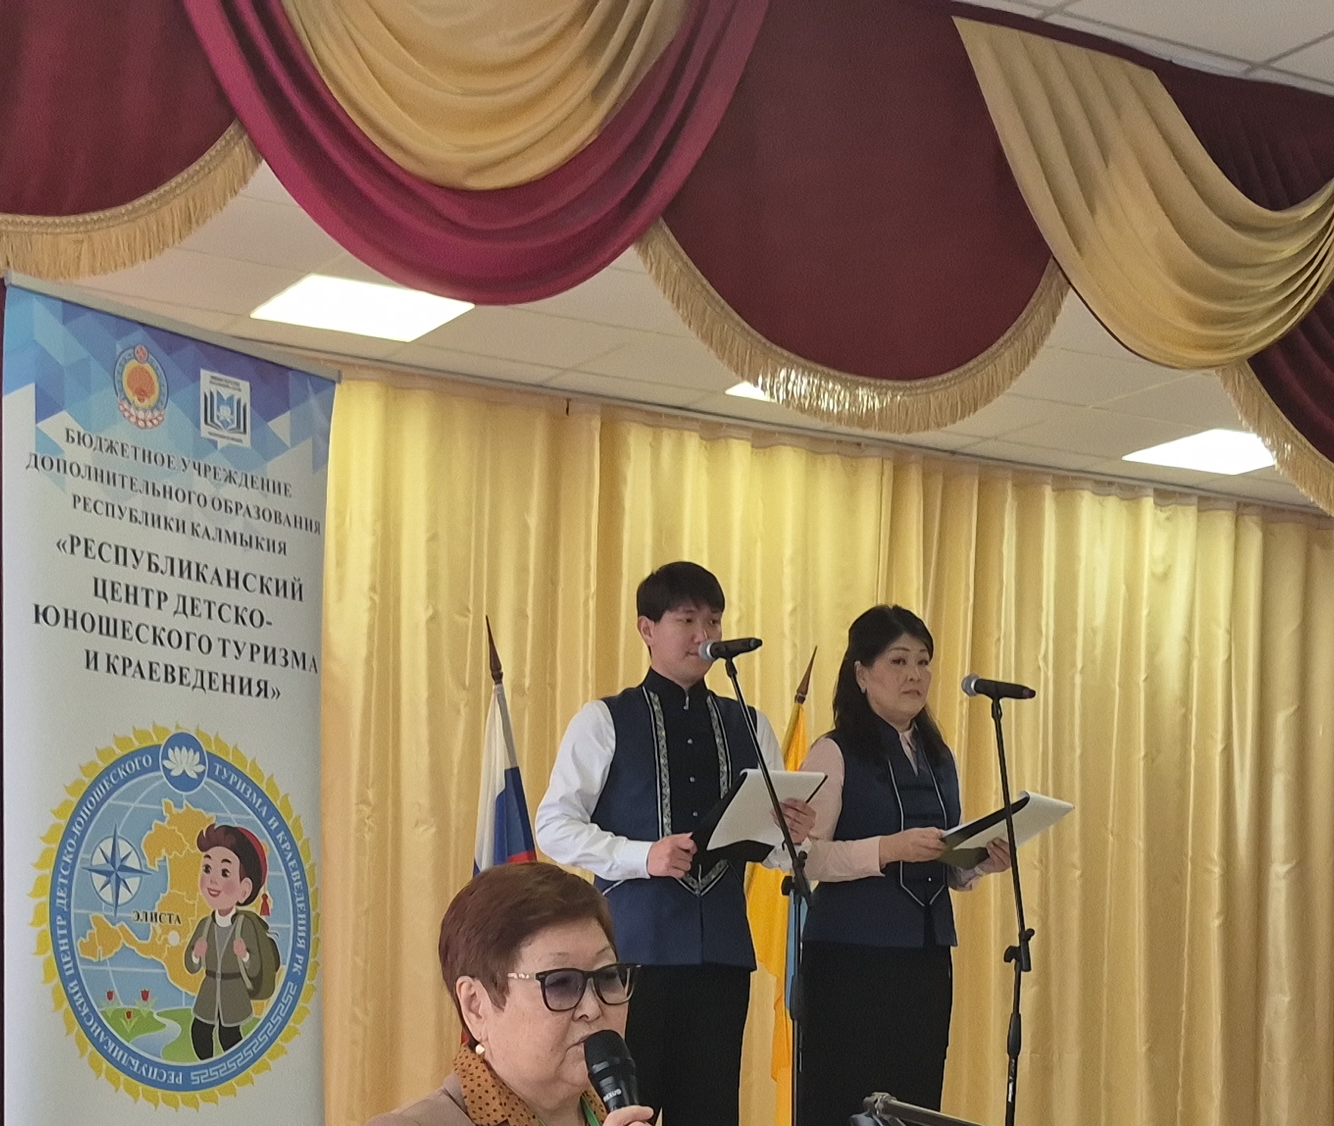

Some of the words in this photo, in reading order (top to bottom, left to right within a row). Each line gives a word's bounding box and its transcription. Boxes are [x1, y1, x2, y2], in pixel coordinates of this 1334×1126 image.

[25, 452, 208, 509] ДОПОЛНИТЕЛЬНОГО
[210, 497, 322, 535] ОБРАЗОВАНИЯ
[65, 427, 177, 471] БЮДЖЕТНОЕ
[180, 458, 293, 499] УЧРЕЖДЕНИЕ
[71, 494, 187, 534] РЕСПУБЛИКИ
[190, 521, 288, 556] КАЛМЫКИЯ
[55, 533, 304, 602] «РЕСПУБЛИКАНСКИЙ
[92, 575, 168, 612] ЦЕНТР
[173, 593, 273, 630] ДЕТСКО-
[33, 603, 213, 656] ЮНОШЕСКОГО
[217, 637, 319, 675] ТУРИЗМА
[84, 649, 99, 672] И
[105, 652, 282, 701] КРАЕВЕДЕНИЯ»
[213, 761, 268, 818] ТУРИЗМА
[267, 815, 278, 831] И
[132, 910, 182, 925] ЭЛИСТА
[276, 830, 307, 949] КРАЕВЕДЕНИЯ
[55, 914, 75, 976] ЦЕНТР
[290, 953, 305, 976] РК
[67, 979, 183, 1085] РЕСПУБЛИКАНСКИЙ
